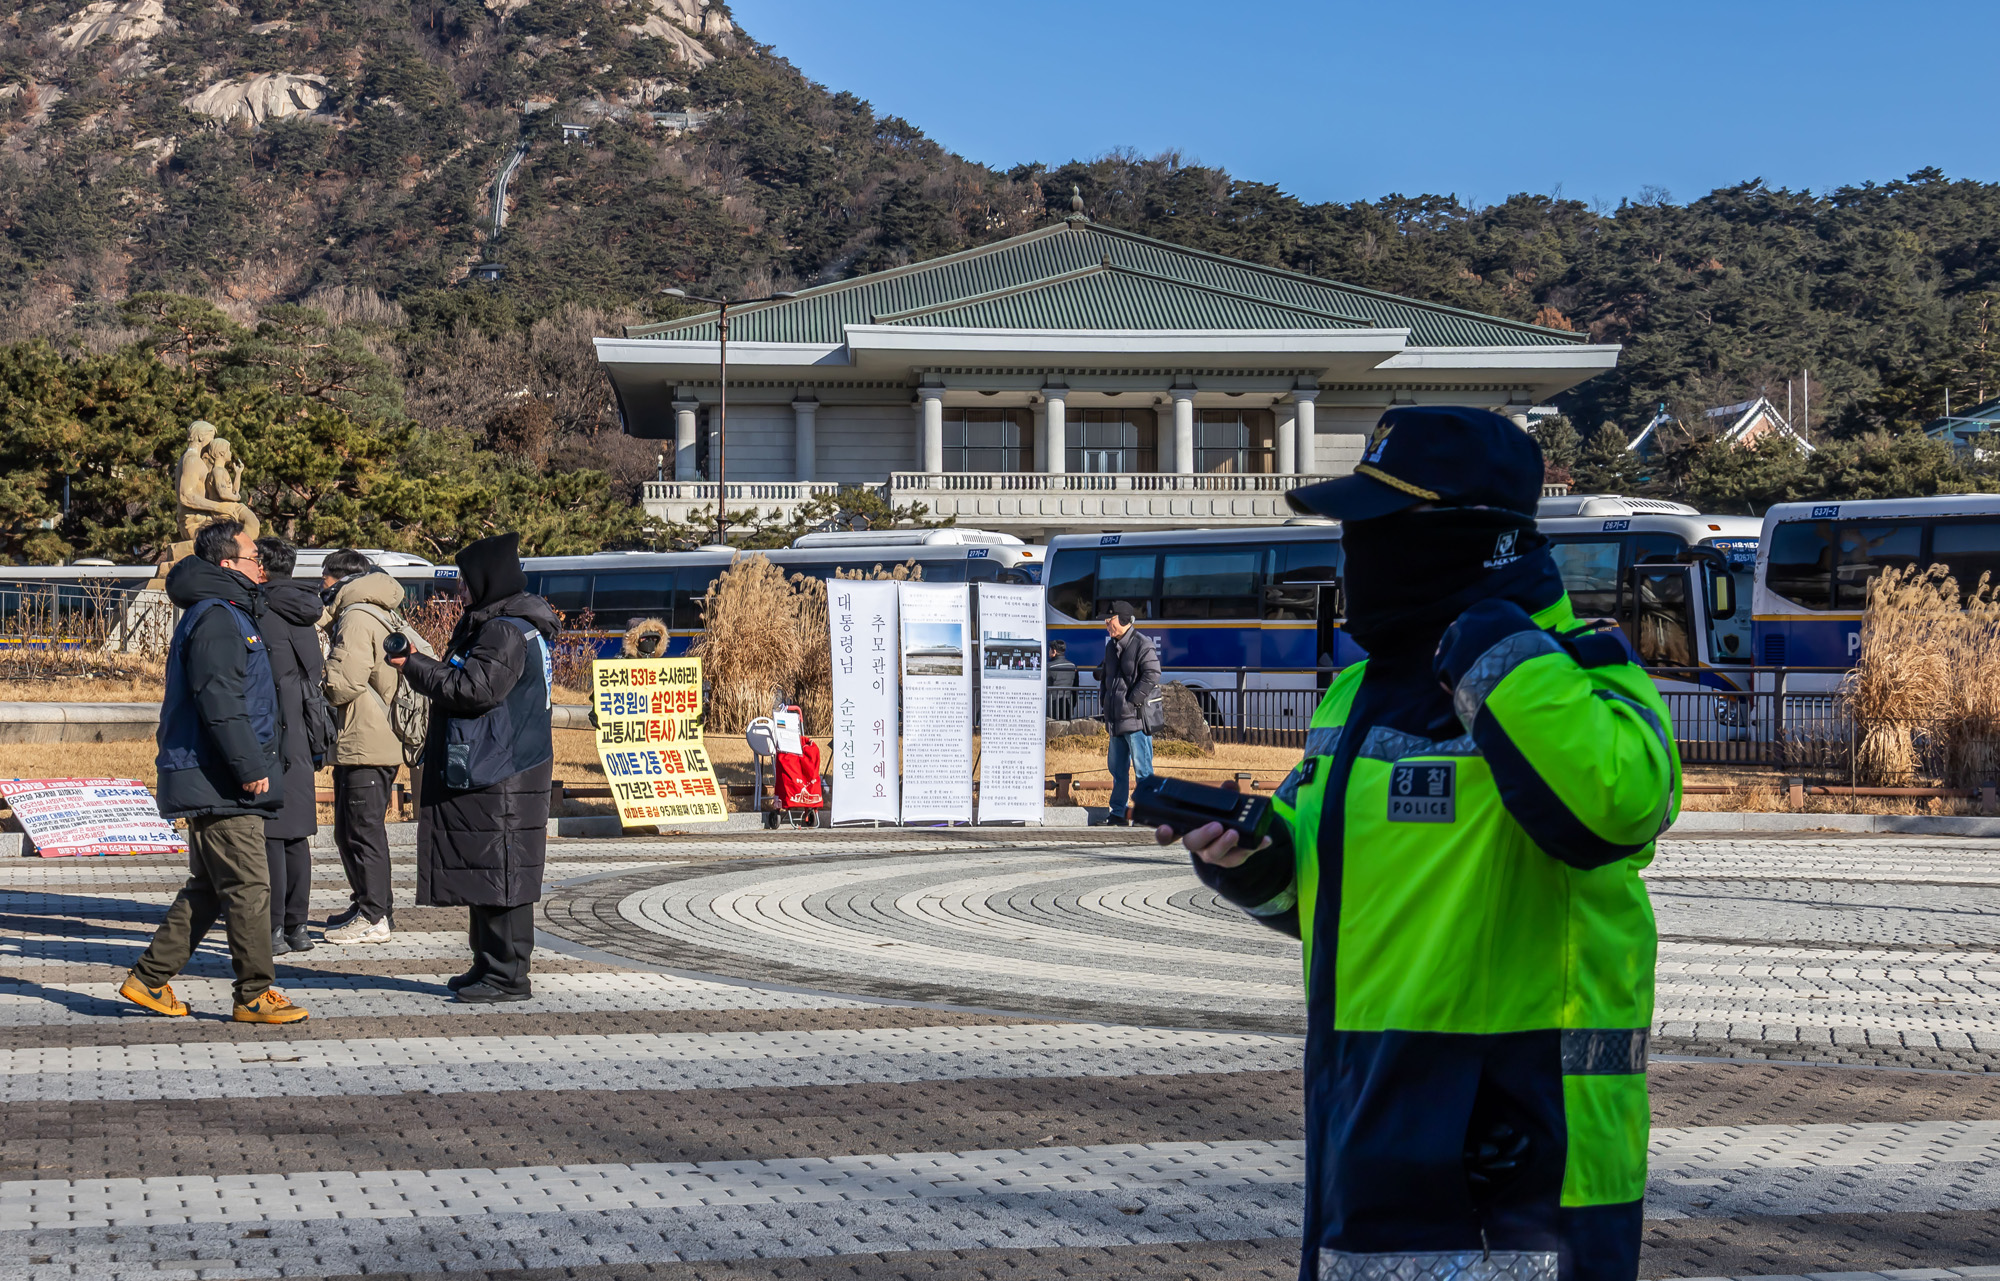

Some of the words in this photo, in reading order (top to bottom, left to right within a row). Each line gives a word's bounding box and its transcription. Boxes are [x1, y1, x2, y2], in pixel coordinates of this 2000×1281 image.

[1814, 507, 1838, 516] 63기-2
[1605, 521, 1628, 529] 26기-3
[838, 593, 854, 674] 대통령님
[872, 614, 886, 696] 추모관이
[599, 668, 629, 687] 공수처
[631, 668, 657, 686] 531호
[659, 667, 697, 685] 수사하라!
[600, 692, 648, 715] 국정원의
[651, 690, 698, 714] 살인청부
[602, 719, 675, 744] 교통사고(즉사)
[678, 719, 698, 740] 시도
[840, 698, 855, 779] 순국선열
[606, 752, 642, 776] 아파트
[640, 751, 662, 775] 2동
[659, 750, 685, 774] 강탈
[684, 749, 708, 772] 시도
[872, 719, 887, 798] 위기예요
[615, 781, 654, 800] 17년간
[653, 780, 682, 798] 공작,
[681, 778, 716, 797] 독극물
[1396, 768, 1447, 795] 경찰
[8, 793, 33, 805] GS건설
[624, 807, 646, 819] 아파트
[646, 806, 660, 818] 공실
[705, 802, 722, 815] 기준)
[1393, 802, 1447, 815] POLICE
[25, 815, 48, 824] 이재명
